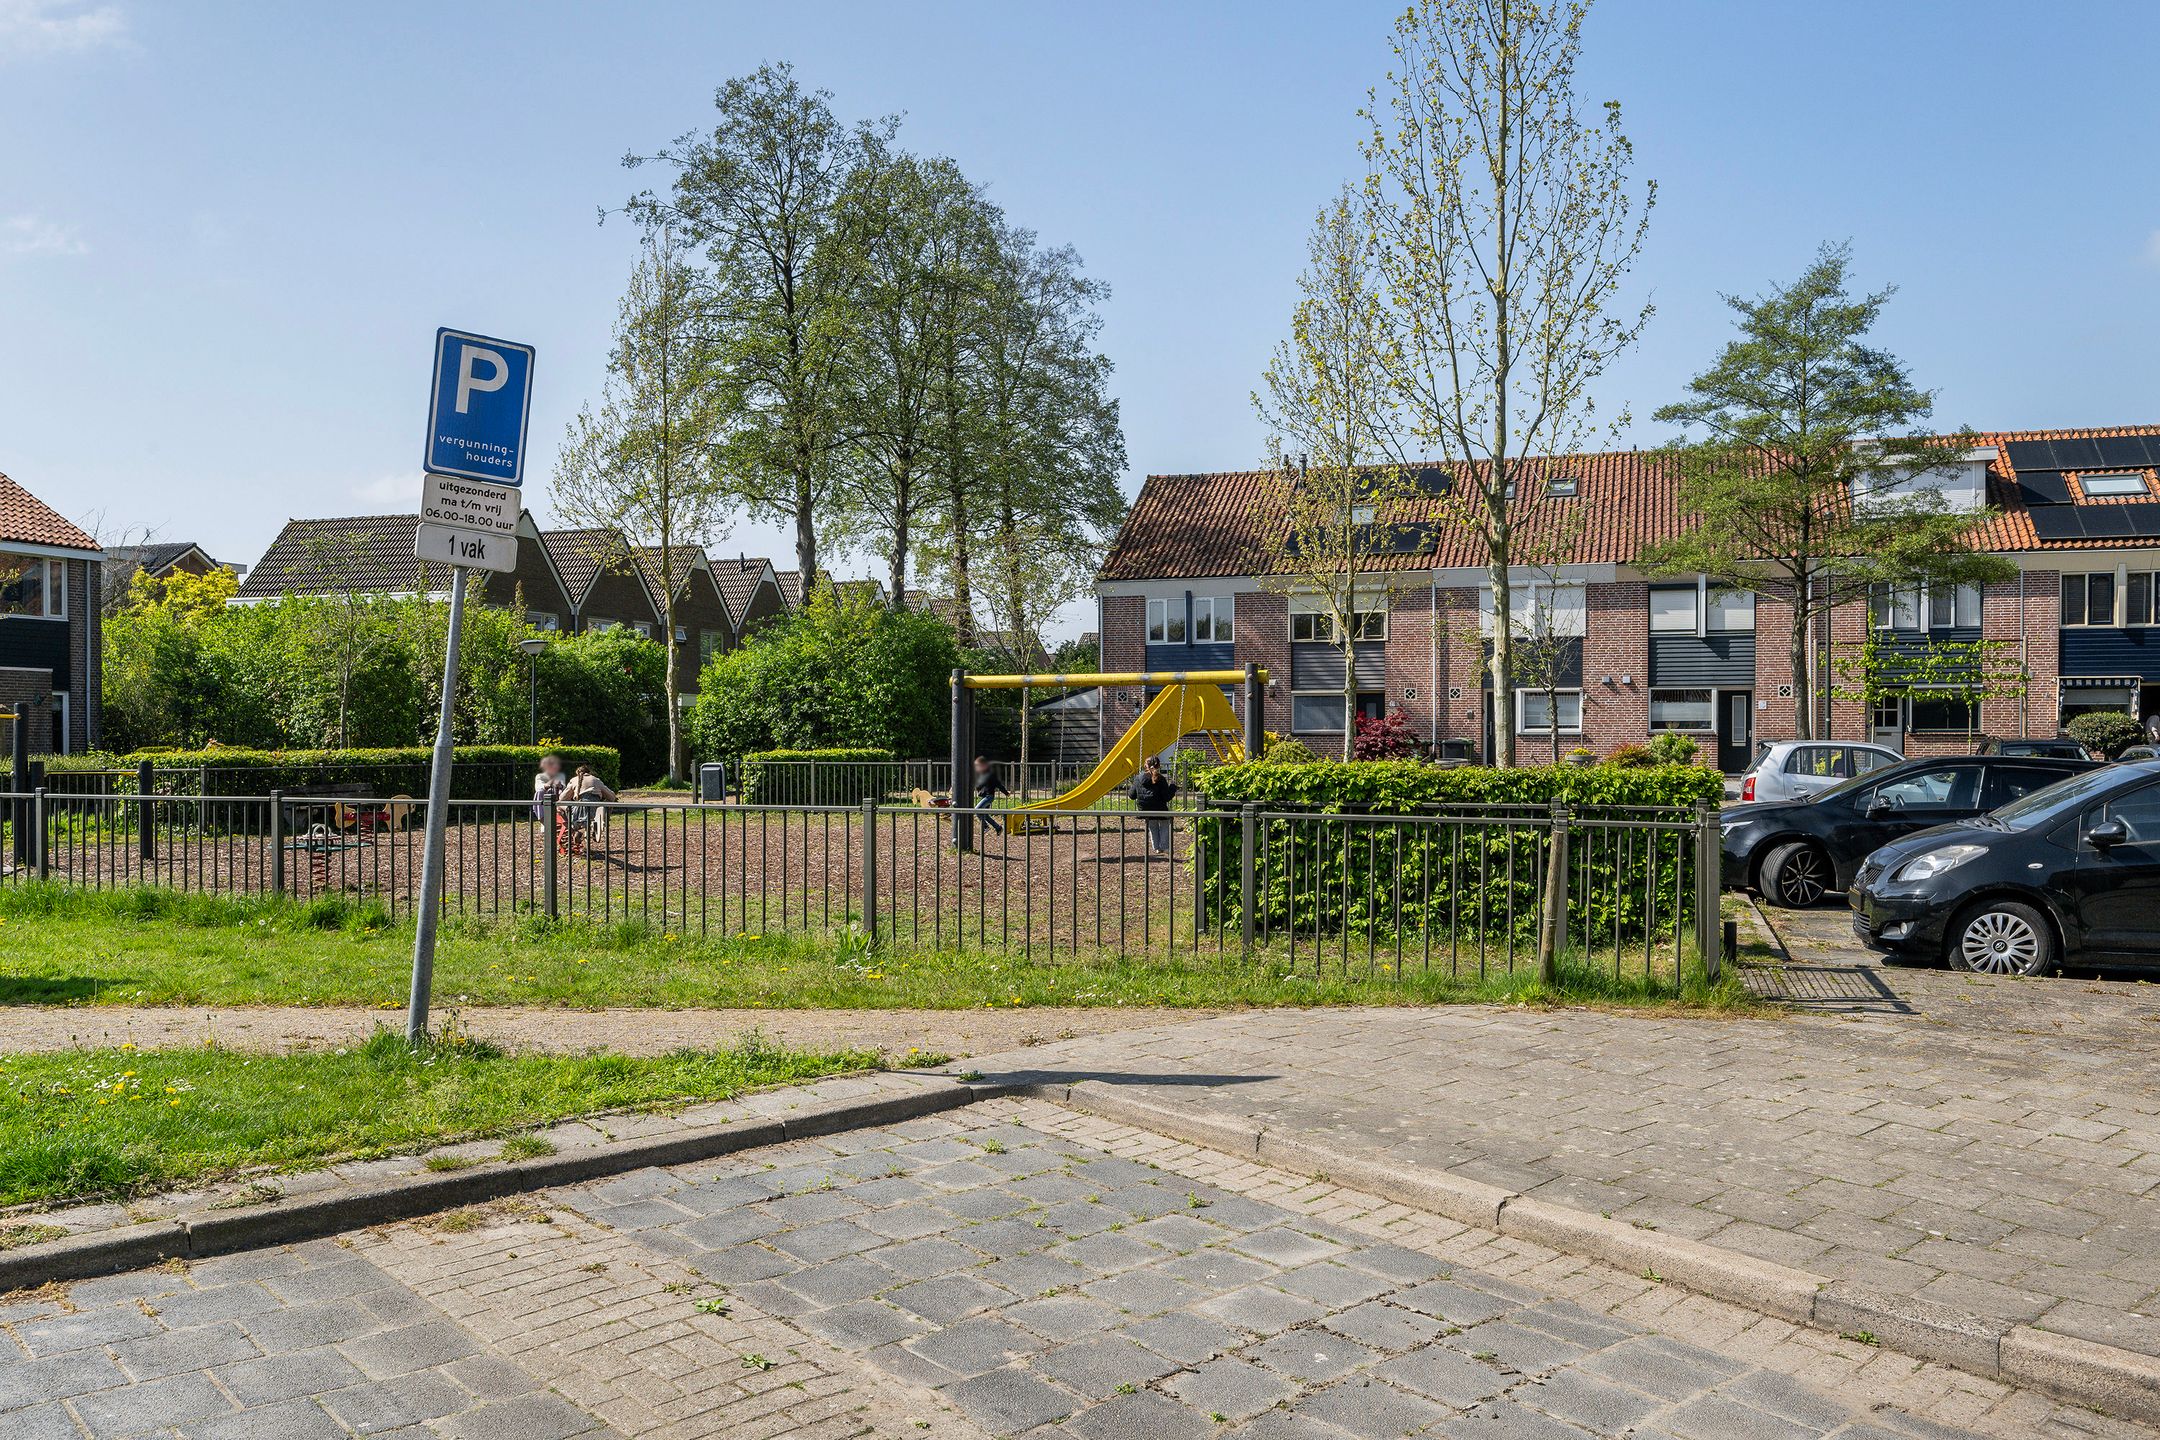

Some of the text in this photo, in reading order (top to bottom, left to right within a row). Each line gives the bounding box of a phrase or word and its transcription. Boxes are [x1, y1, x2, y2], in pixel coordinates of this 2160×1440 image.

[455, 344, 509, 414] P
[439, 435, 514, 456] vergunning-
[466, 452, 513, 467] houders
[439, 482, 507, 500] uitgezonderd
[441, 497, 502, 516] ma t/m vrij
[425, 508, 514, 531] 06.00-18.00 uur
[448, 535, 486, 560] 1 vak
